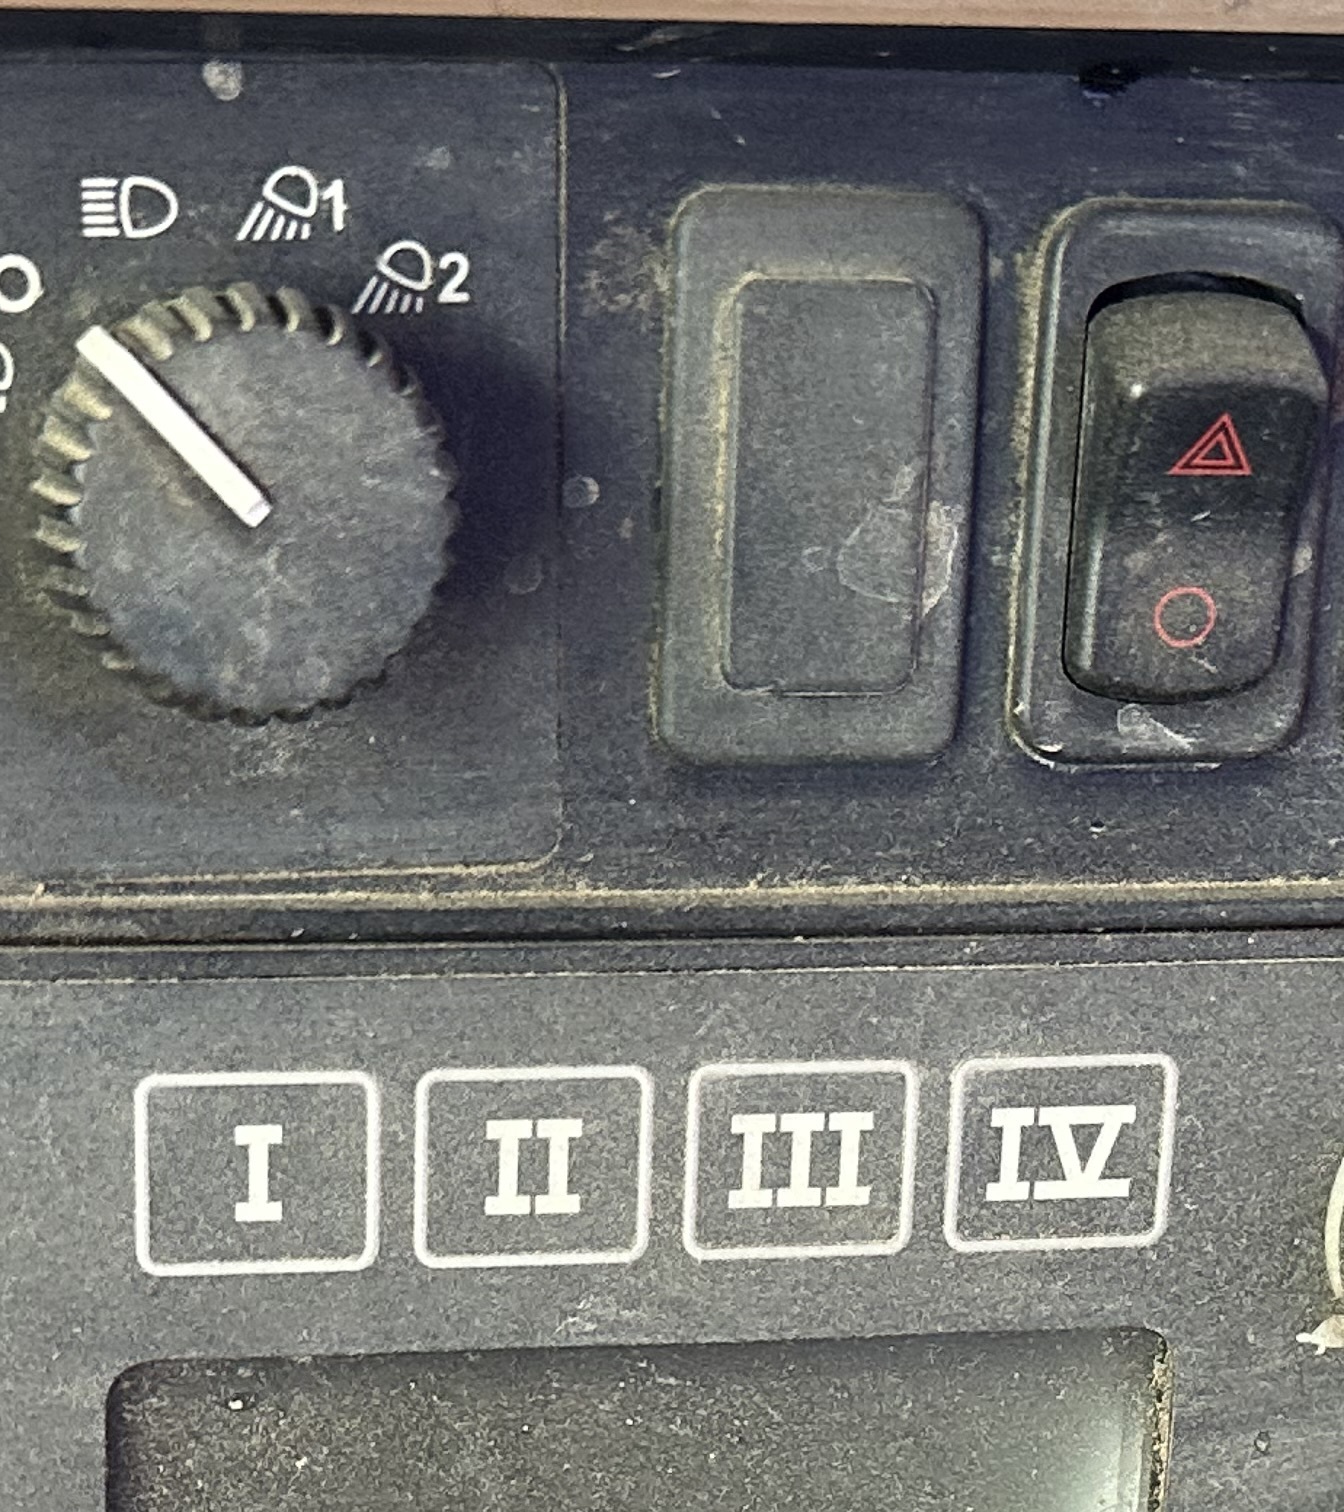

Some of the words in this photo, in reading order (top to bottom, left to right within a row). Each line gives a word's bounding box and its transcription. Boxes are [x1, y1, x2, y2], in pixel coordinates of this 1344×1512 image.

[436, 251, 471, 304] 2
[233, 1123, 283, 1222] I
[484, 1117, 582, 1216] II
[727, 1110, 874, 1209] III
[985, 1103, 1136, 1201] IV
